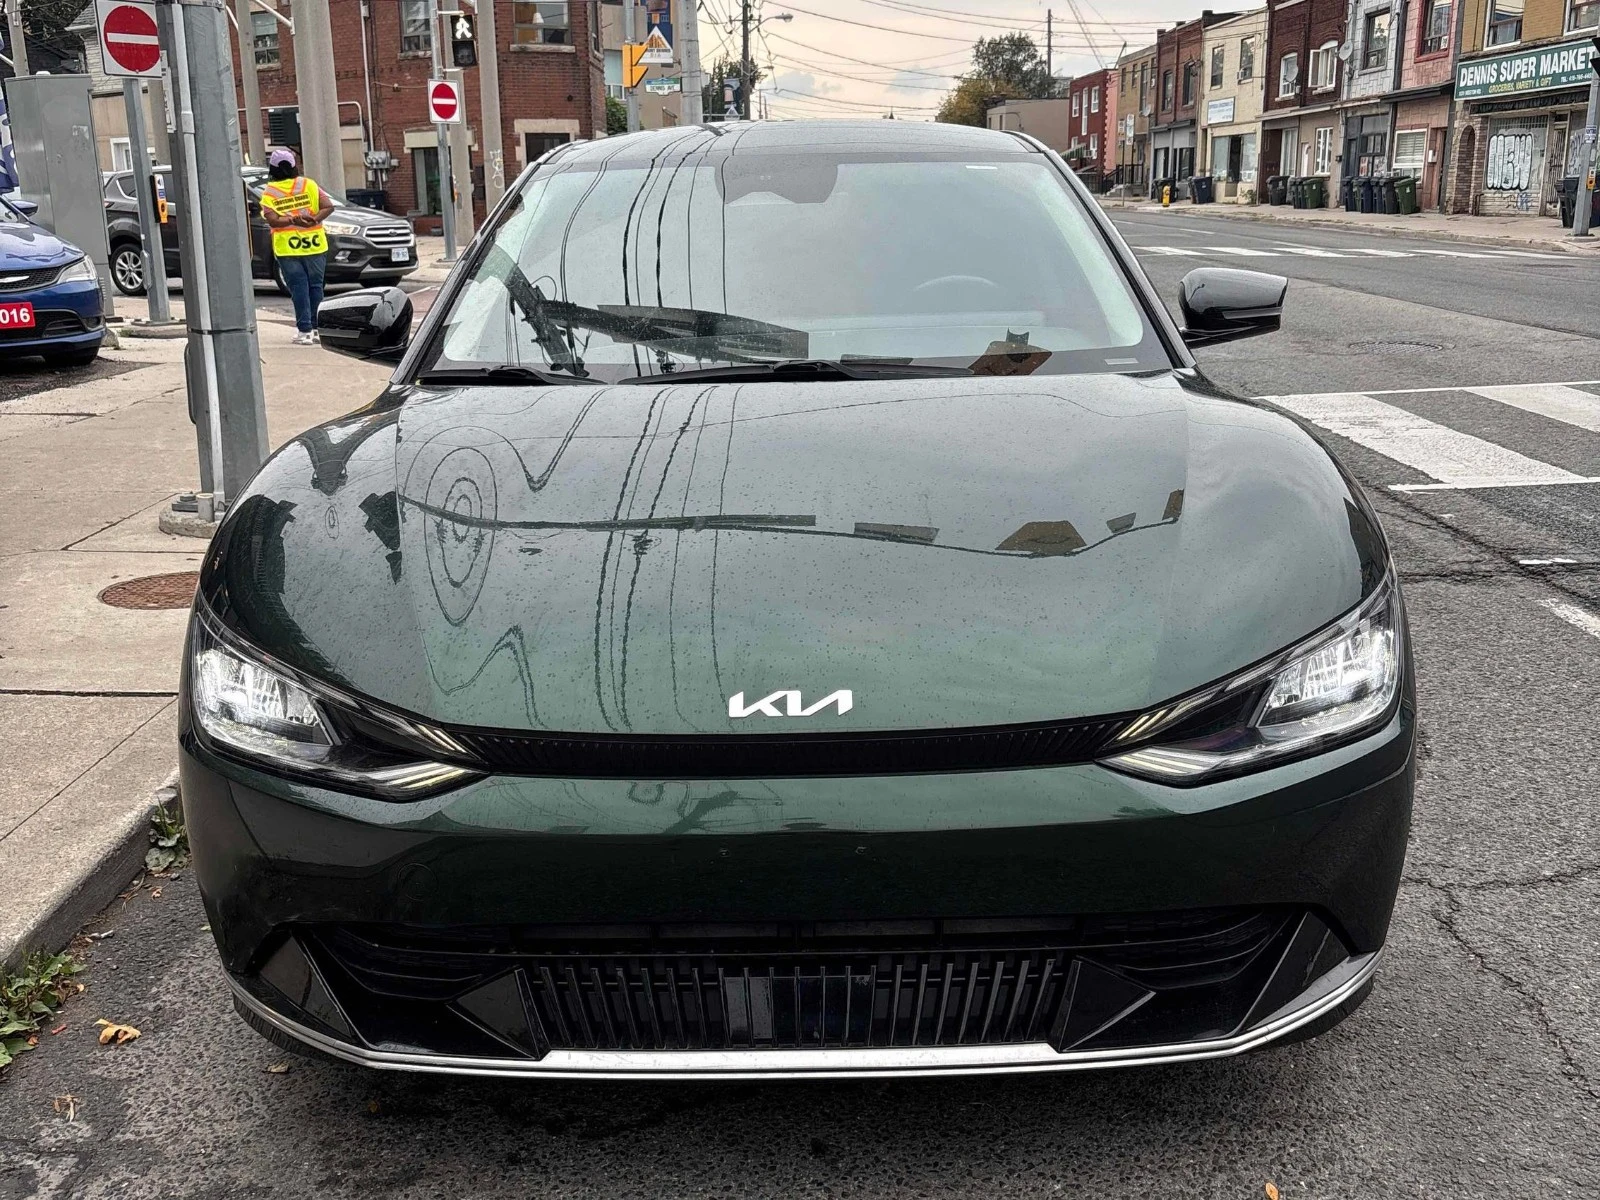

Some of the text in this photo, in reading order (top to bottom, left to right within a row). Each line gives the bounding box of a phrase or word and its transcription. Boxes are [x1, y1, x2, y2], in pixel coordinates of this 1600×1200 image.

[1460, 45, 1596, 87] DENNIS SUPER MARKET
[1488, 82, 1515, 93] GROCERIES,
[1515, 79, 1536, 90] VARIETY
[1540, 76, 1552, 87] GIFT
[288, 234, 321, 249] OSC
[728, 689, 853, 718] KIA
